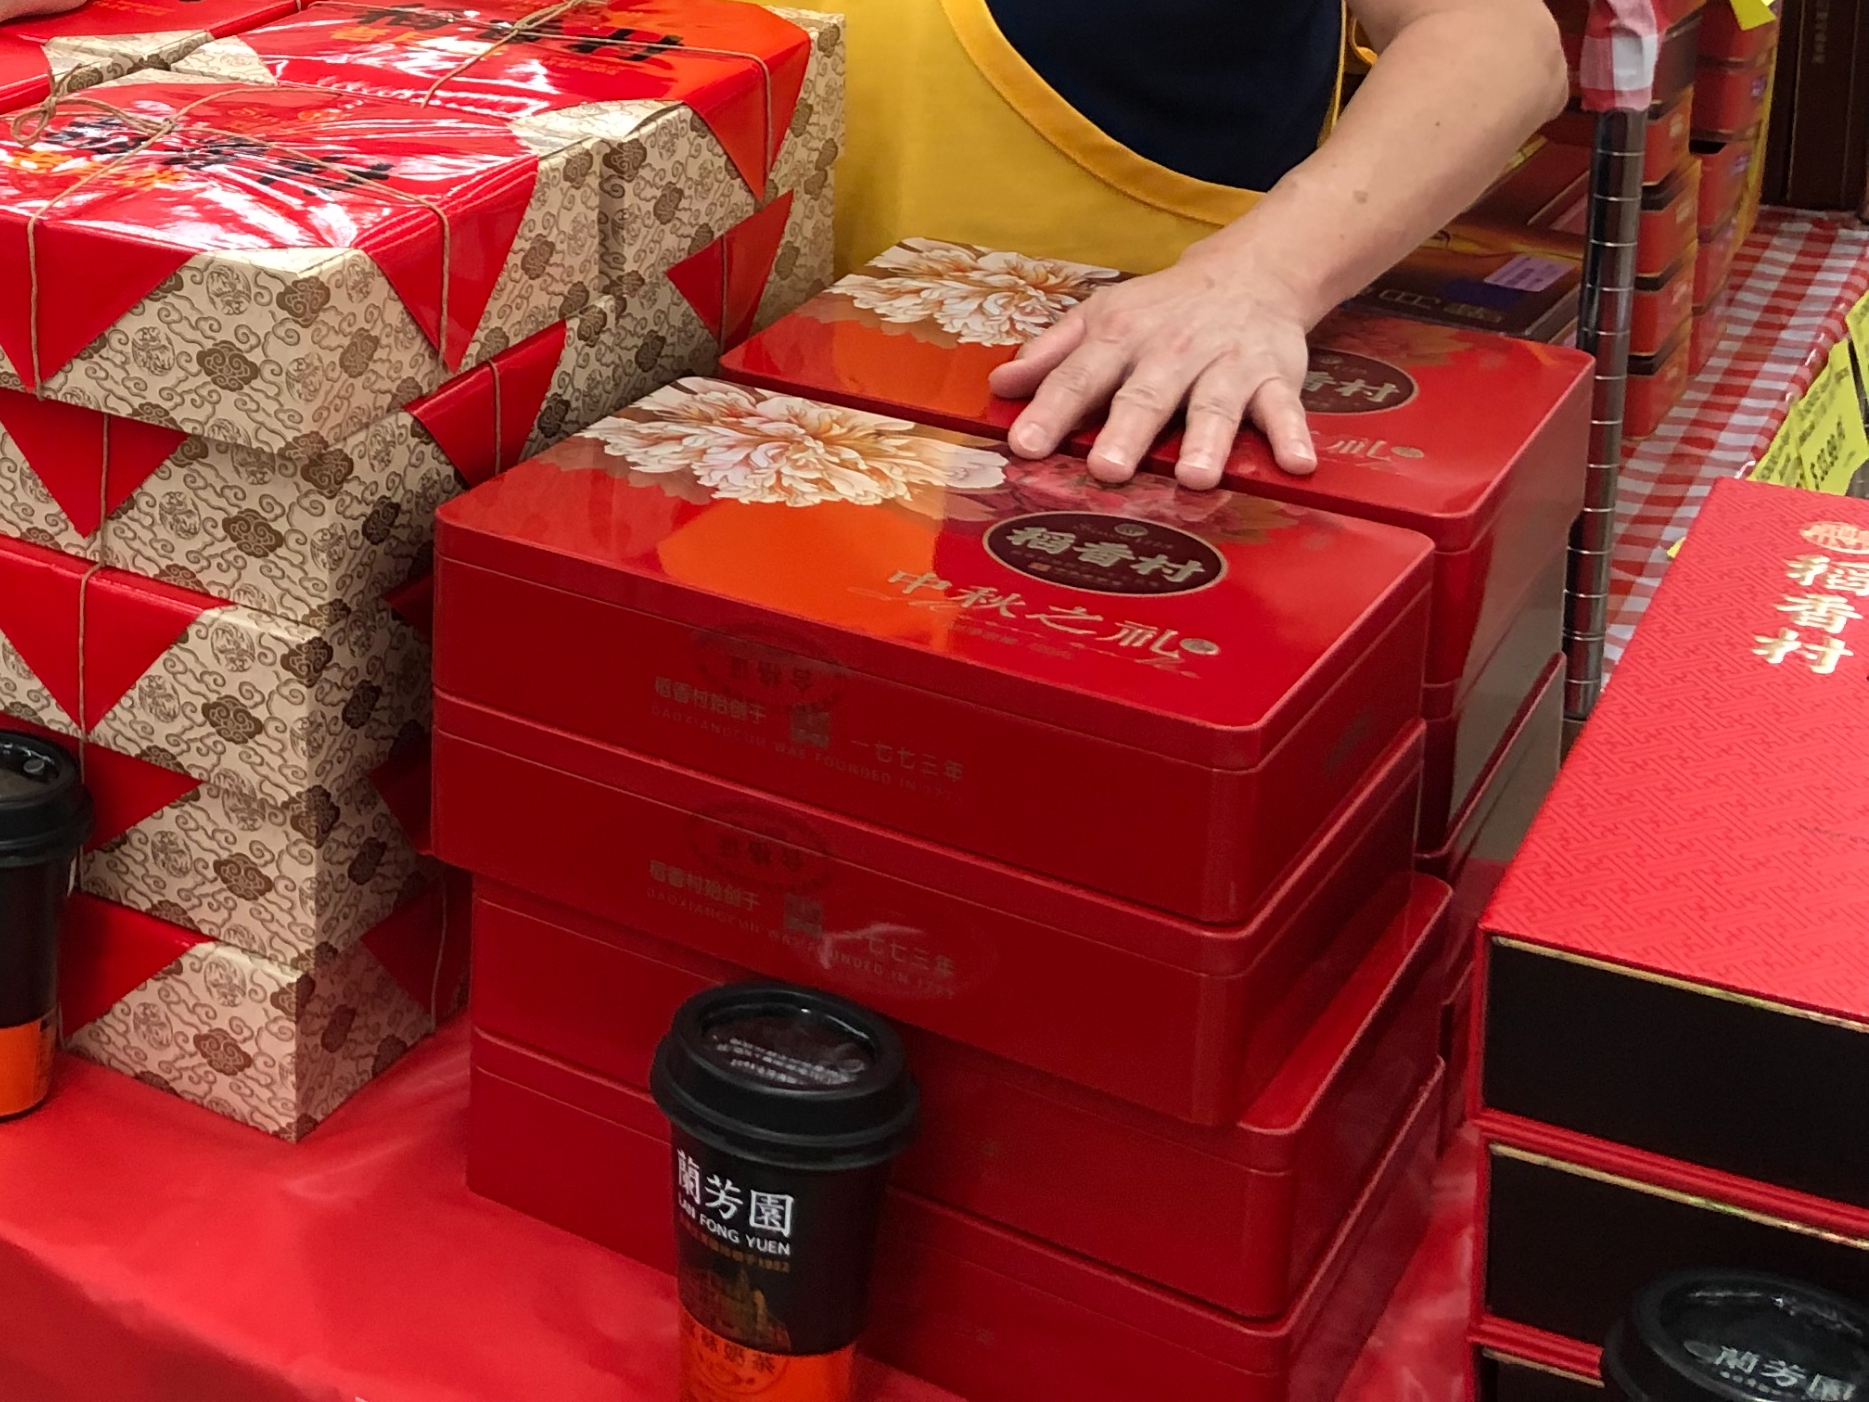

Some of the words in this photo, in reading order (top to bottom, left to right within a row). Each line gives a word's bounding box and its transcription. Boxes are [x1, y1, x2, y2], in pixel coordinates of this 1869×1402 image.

[1006, 527, 1205, 582] 稻香村
[677, 1149, 795, 1238] 蘭芳園
[699, 1214, 740, 1244] FONG
[745, 1234, 791, 1257] YUEN
